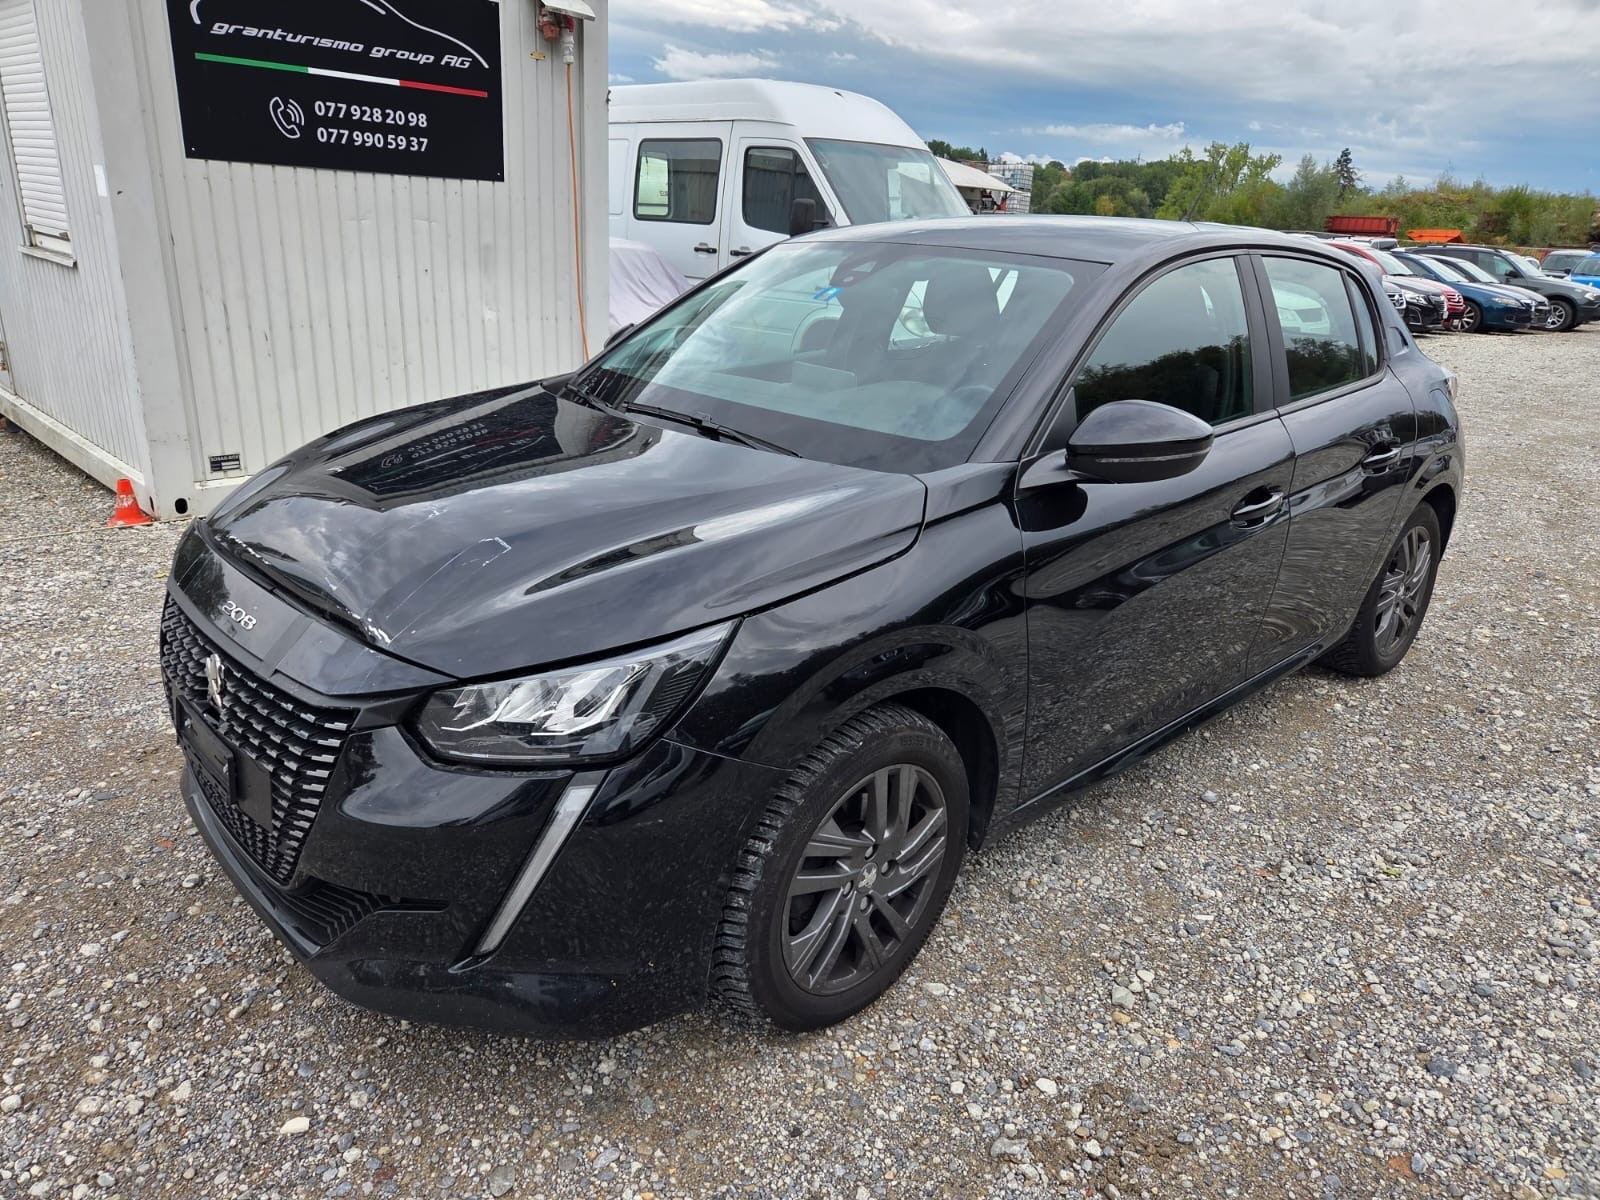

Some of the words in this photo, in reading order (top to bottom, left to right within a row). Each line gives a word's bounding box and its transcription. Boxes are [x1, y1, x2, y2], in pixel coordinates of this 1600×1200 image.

[210, 21, 363, 52] granturismo
[369, 46, 435, 64] group
[440, 54, 472, 69] AG
[314, 100, 347, 118] 077
[350, 105, 383, 123] 928
[385, 109, 405, 125] 20
[407, 112, 428, 128] 98
[316, 127, 349, 145] 077
[352, 131, 384, 148] 990
[387, 134, 407, 150] 59
[409, 137, 428, 152] 37
[222, 601, 257, 630] 208
